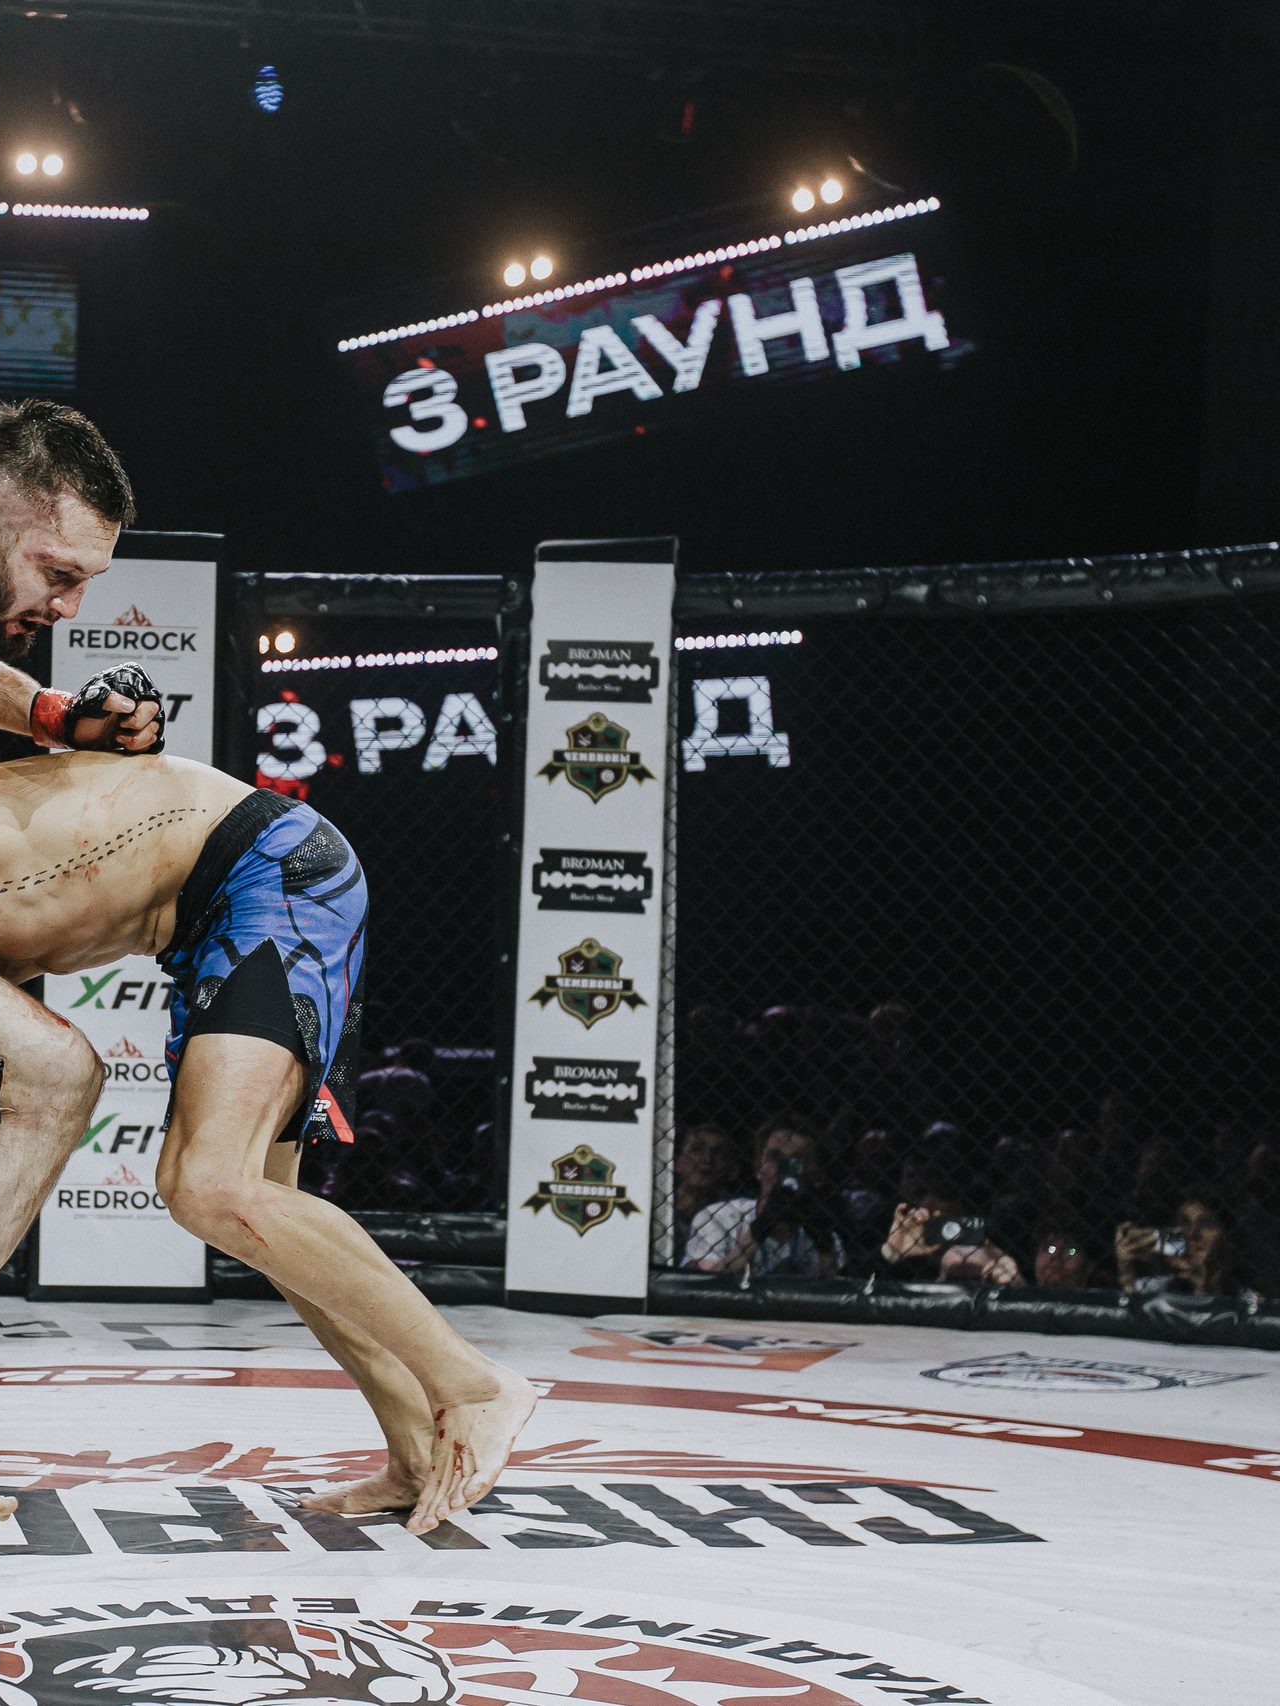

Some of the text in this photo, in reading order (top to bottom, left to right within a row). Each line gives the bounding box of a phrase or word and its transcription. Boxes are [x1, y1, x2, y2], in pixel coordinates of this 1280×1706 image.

[383, 252, 950, 453] 3 РАУНД
[69, 628, 198, 652] REDROCK
[569, 648, 632, 661] BROMAN
[256, 701, 326, 780] 3
[561, 856, 625, 870] BROMAN
[554, 1065, 618, 1080] BROMAN
[58, 1190, 168, 1210] REDROC
[737, 1400, 1084, 1438] MFP
[410, 1599, 993, 1706] КАДЕМИЯ
